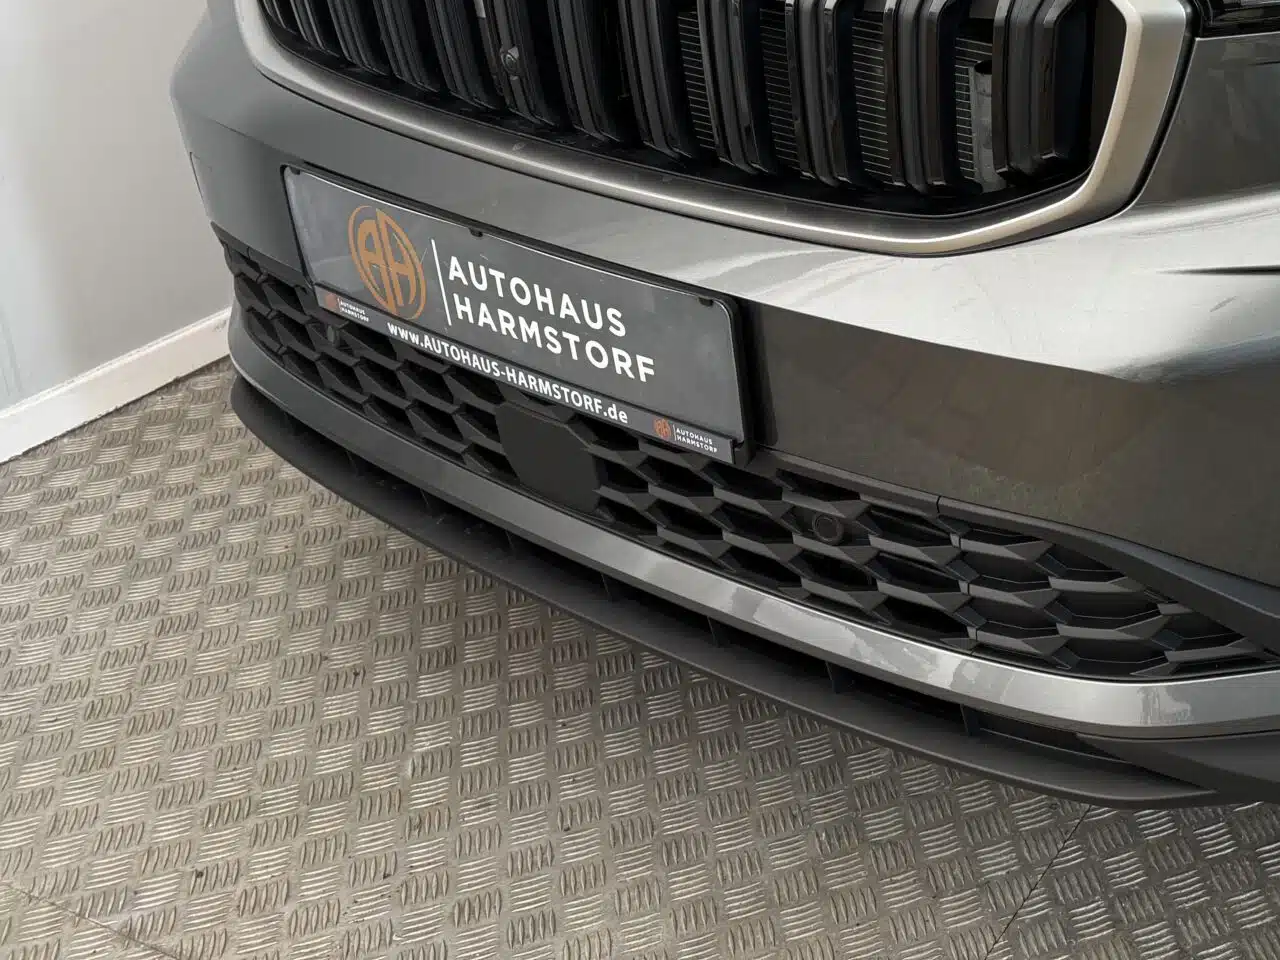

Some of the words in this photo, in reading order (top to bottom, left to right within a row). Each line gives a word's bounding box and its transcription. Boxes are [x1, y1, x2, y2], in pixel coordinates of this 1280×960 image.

[448, 255, 626, 337] AUTOHAUS
[386, 321, 629, 425] www.AUTOHAUS-HARMSTORF.de
[453, 292, 655, 383] HARMSTORF
[676, 427, 713, 445] AUTOHAUS
[676, 435, 718, 453] HARMSTORF
